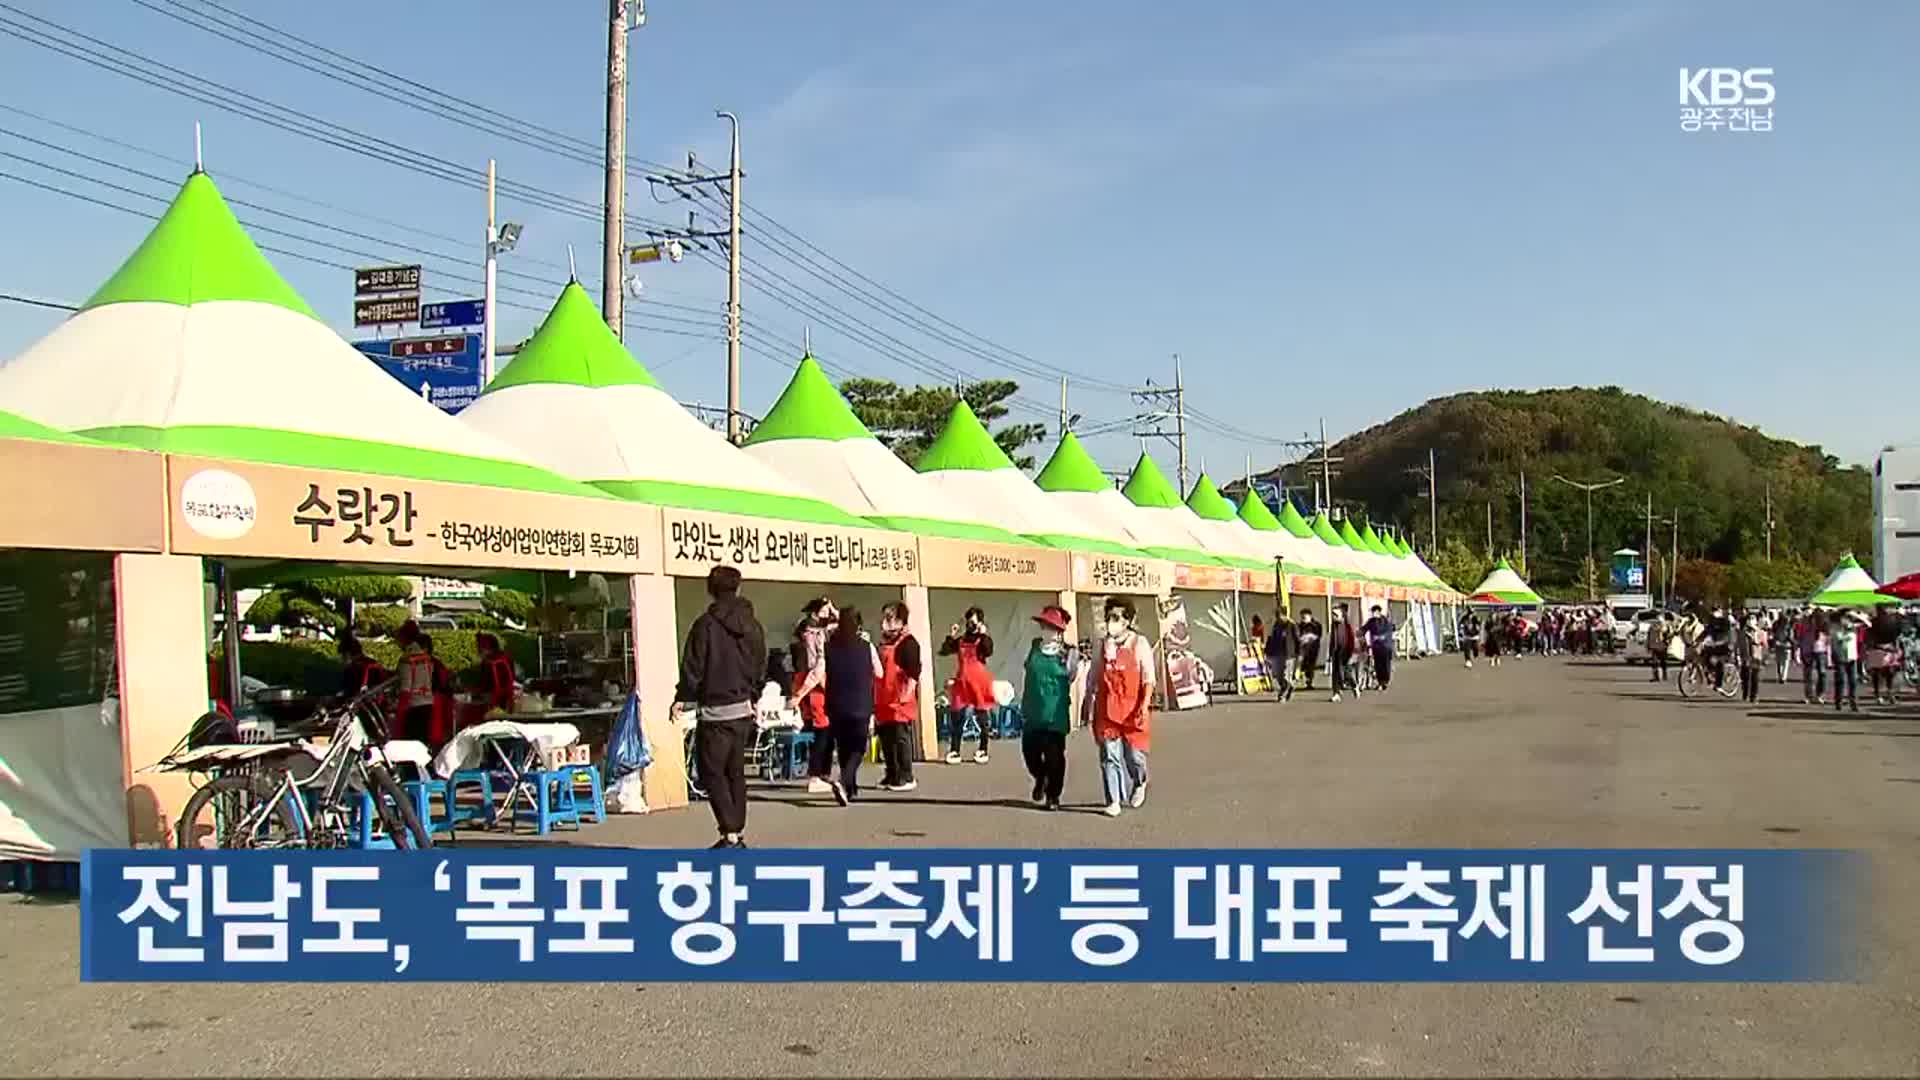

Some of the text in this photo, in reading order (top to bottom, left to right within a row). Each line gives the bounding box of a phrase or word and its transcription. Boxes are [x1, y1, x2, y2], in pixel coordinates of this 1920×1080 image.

[293, 483, 418, 547] 수랏간
[589, 532, 640, 559] 목포지회
[671, 519, 724, 562] 맛있는
[728, 525, 760, 564] 생선
[764, 530, 809, 568] 요리해
